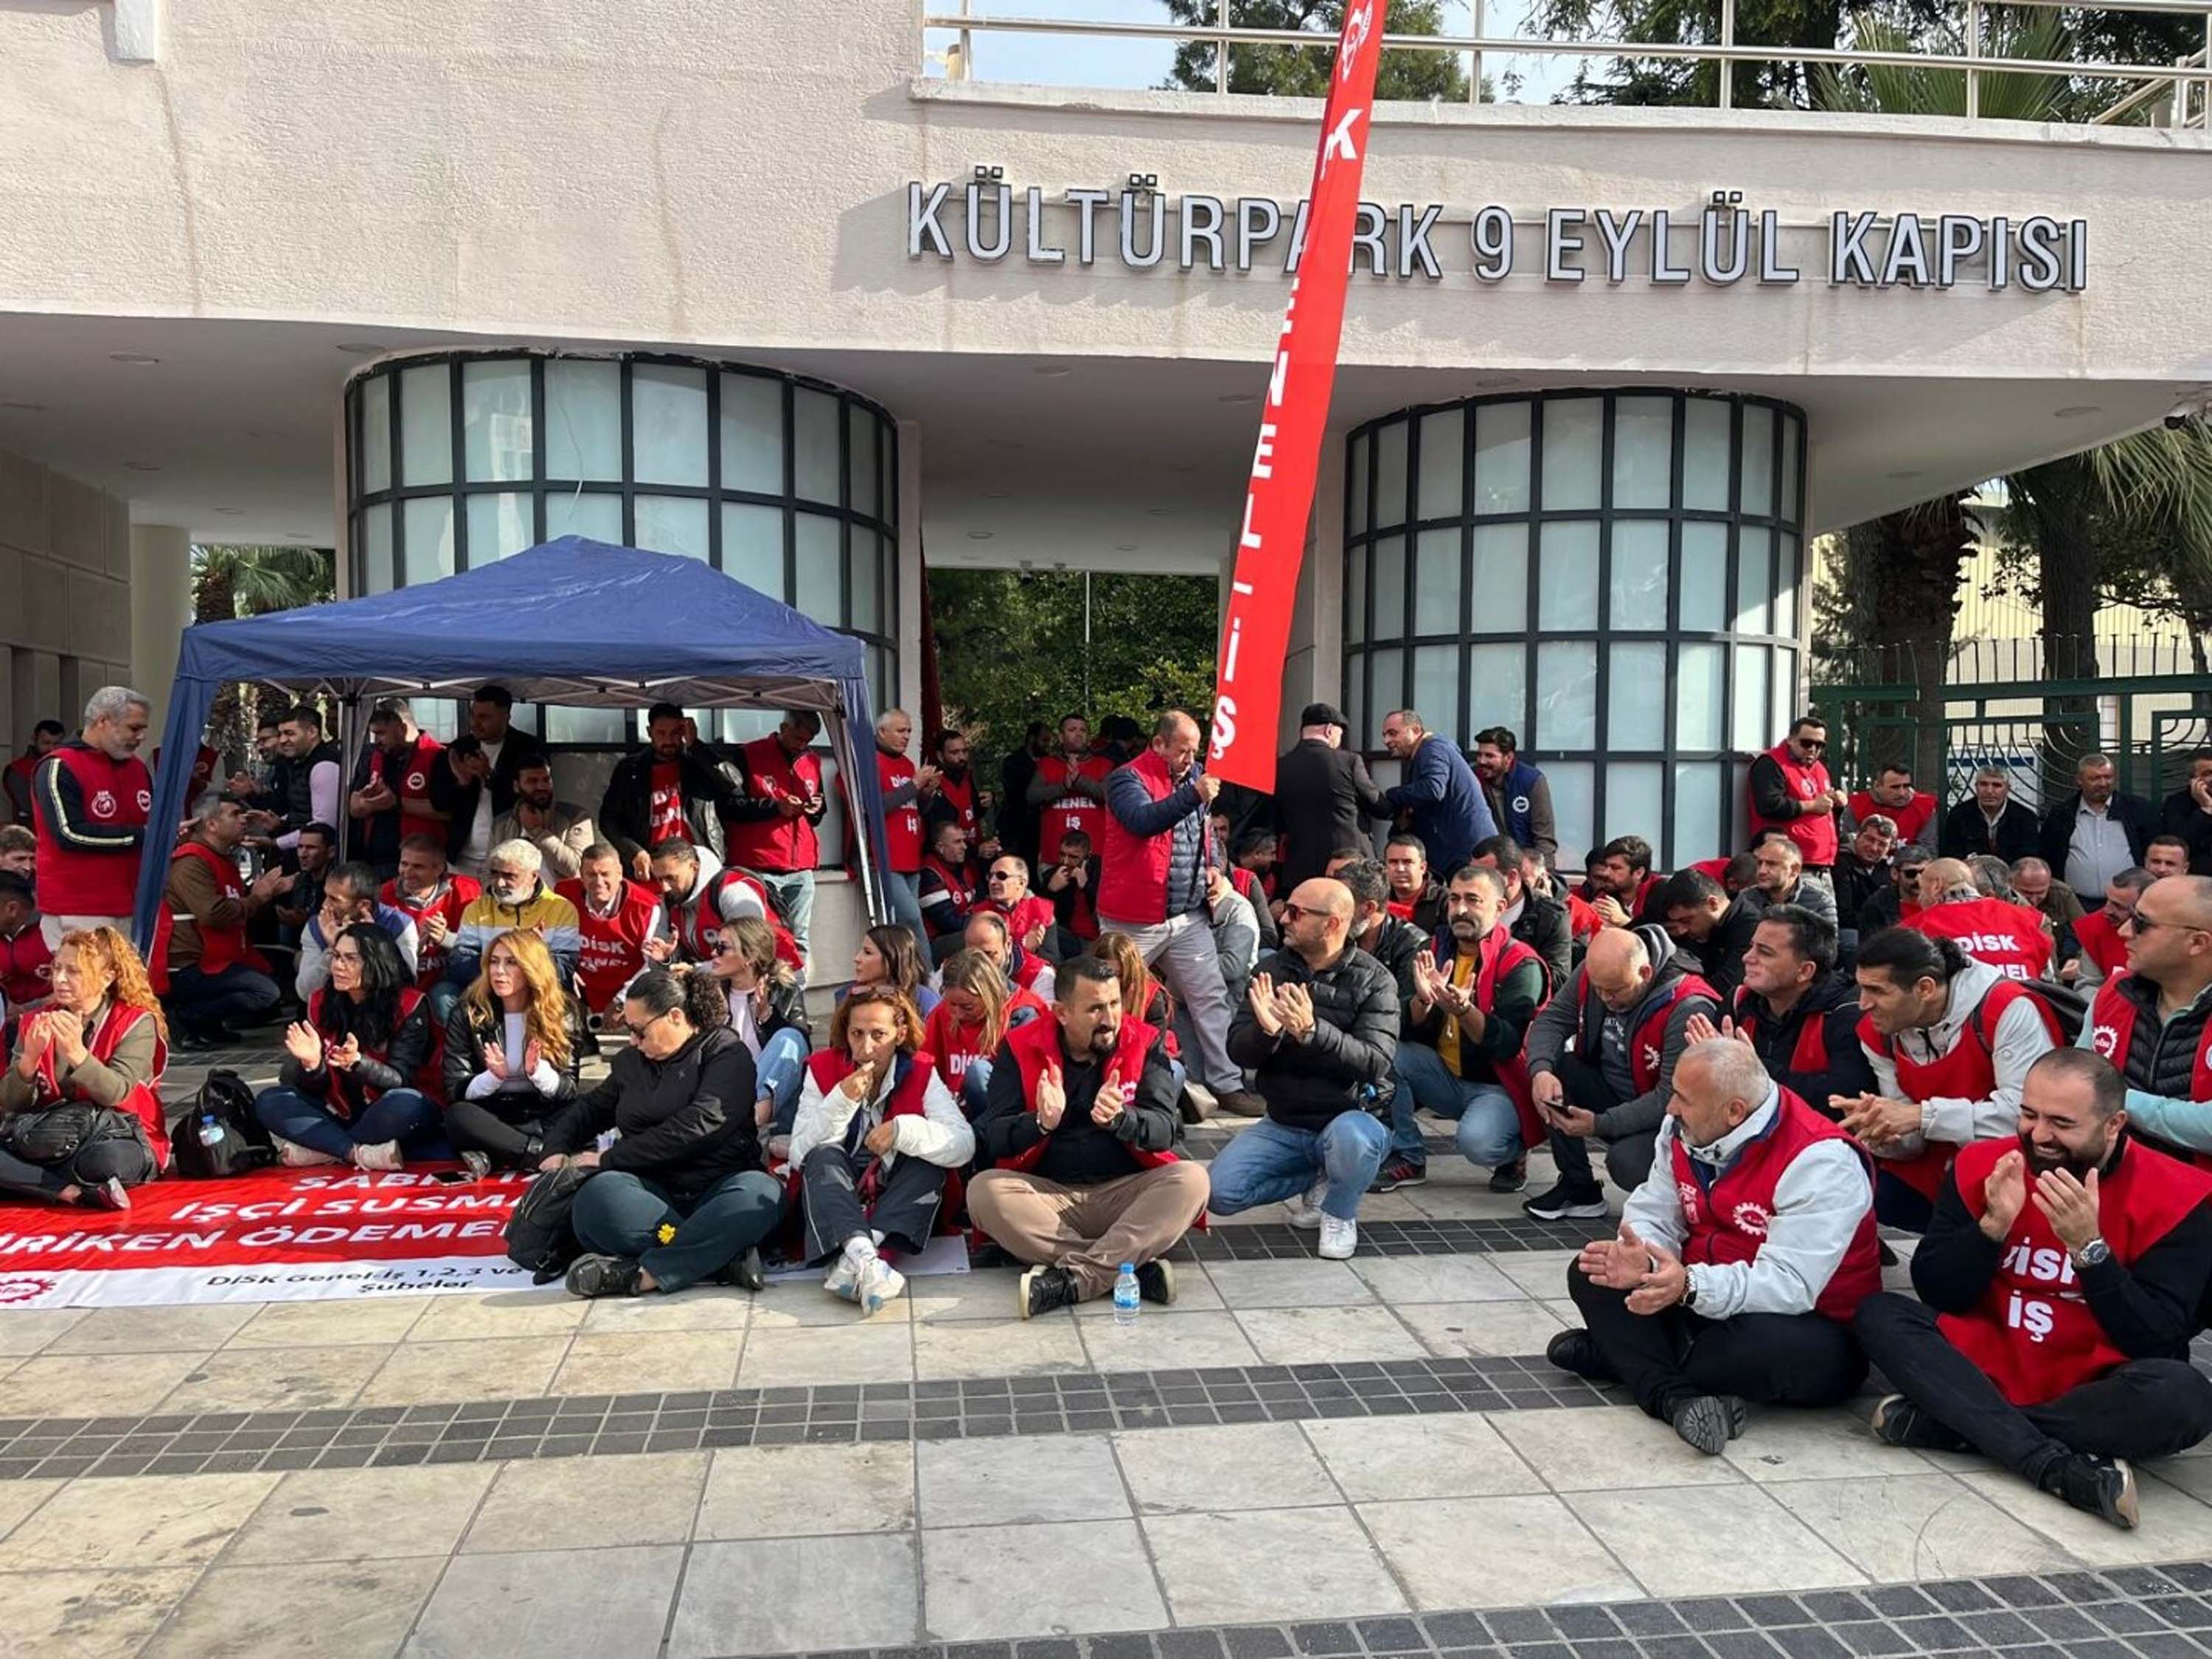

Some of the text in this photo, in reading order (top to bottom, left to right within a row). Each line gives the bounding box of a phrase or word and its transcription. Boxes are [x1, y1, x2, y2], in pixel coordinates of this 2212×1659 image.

[1472, 204, 1514, 282] 9
[1545, 190, 1800, 286] EYLÜL
[1829, 212, 2087, 292] KAPISI
[578, 933, 626, 955] DİSK
[1952, 931, 2021, 953] DİSK
[237, 1220, 510, 1248] ÖDEME
[2008, 1289, 2053, 1343] İŞ
